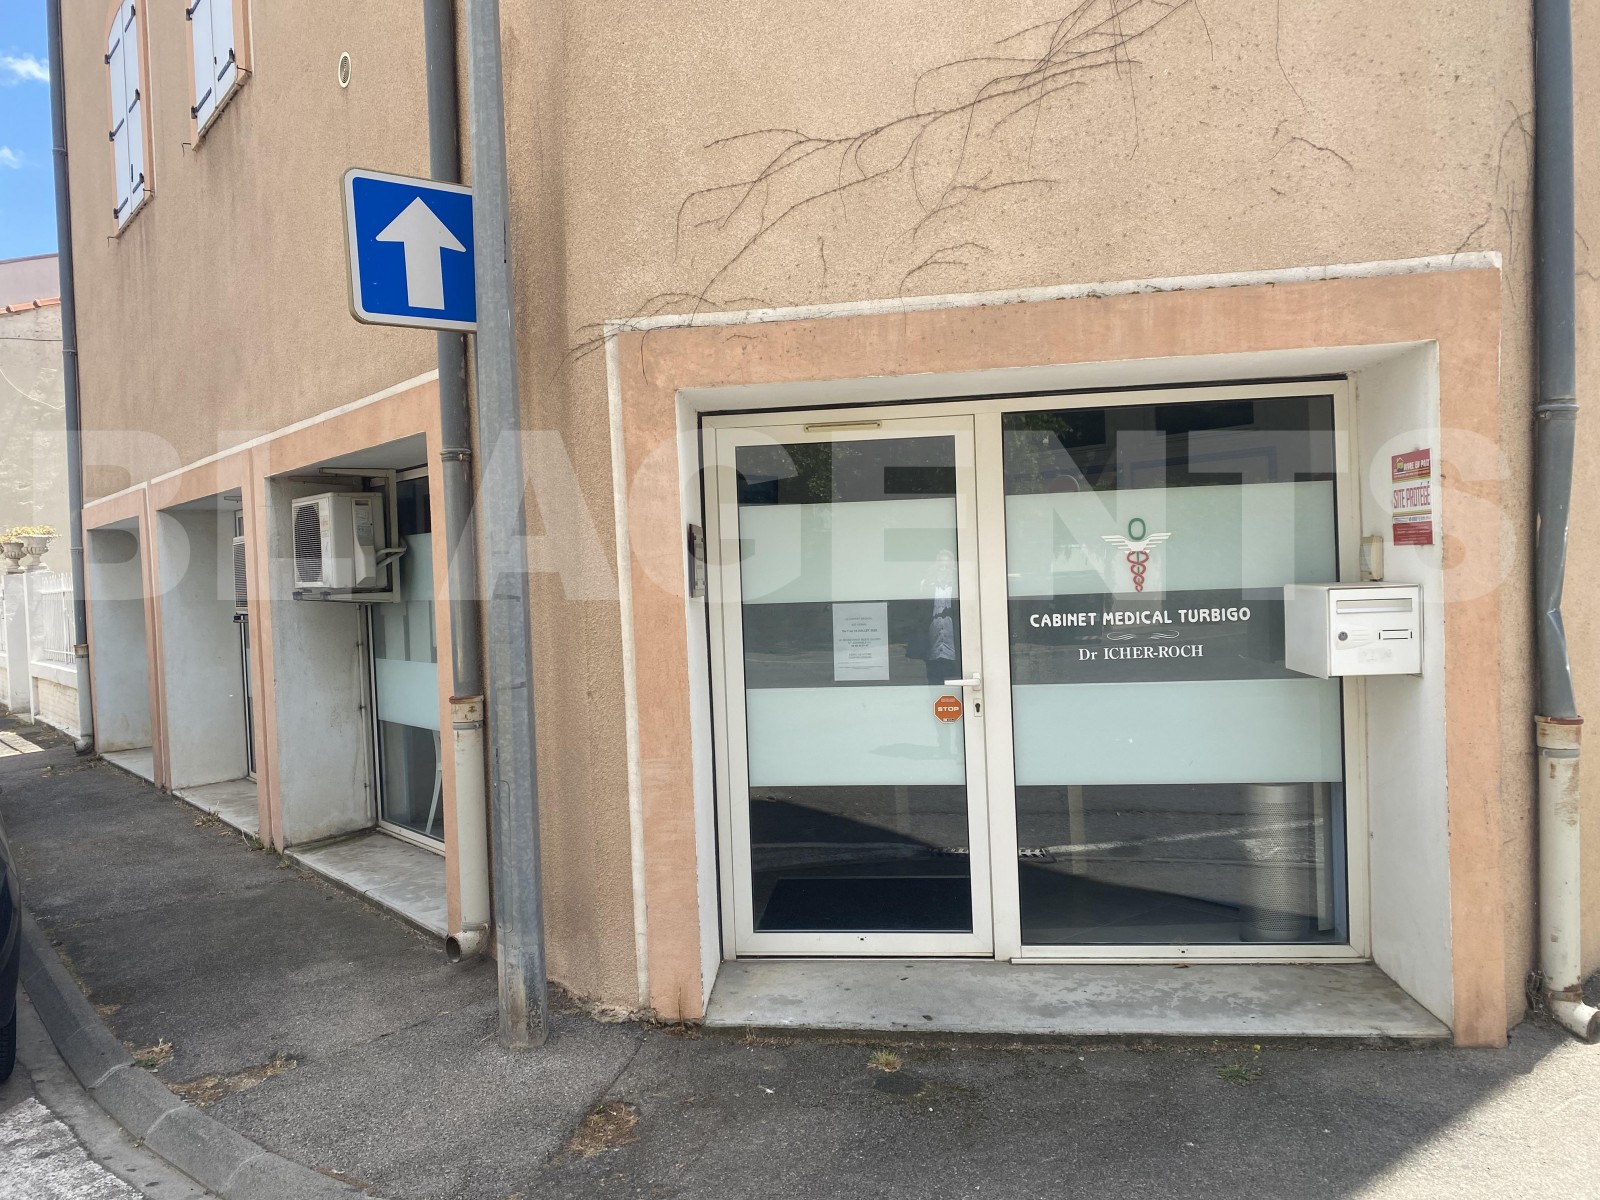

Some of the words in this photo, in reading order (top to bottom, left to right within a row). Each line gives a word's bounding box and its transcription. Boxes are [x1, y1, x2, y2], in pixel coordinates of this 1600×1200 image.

[1393, 488, 1405, 509] SITE
[1406, 480, 1430, 508] PROTÉGÉ
[1029, 612, 1097, 628] CABINET
[1102, 610, 1173, 626] MEDICAL
[1177, 607, 1251, 623] TURBIGO
[1078, 648, 1098, 661] Dr
[1103, 644, 1204, 660] ICHER-ROCH
